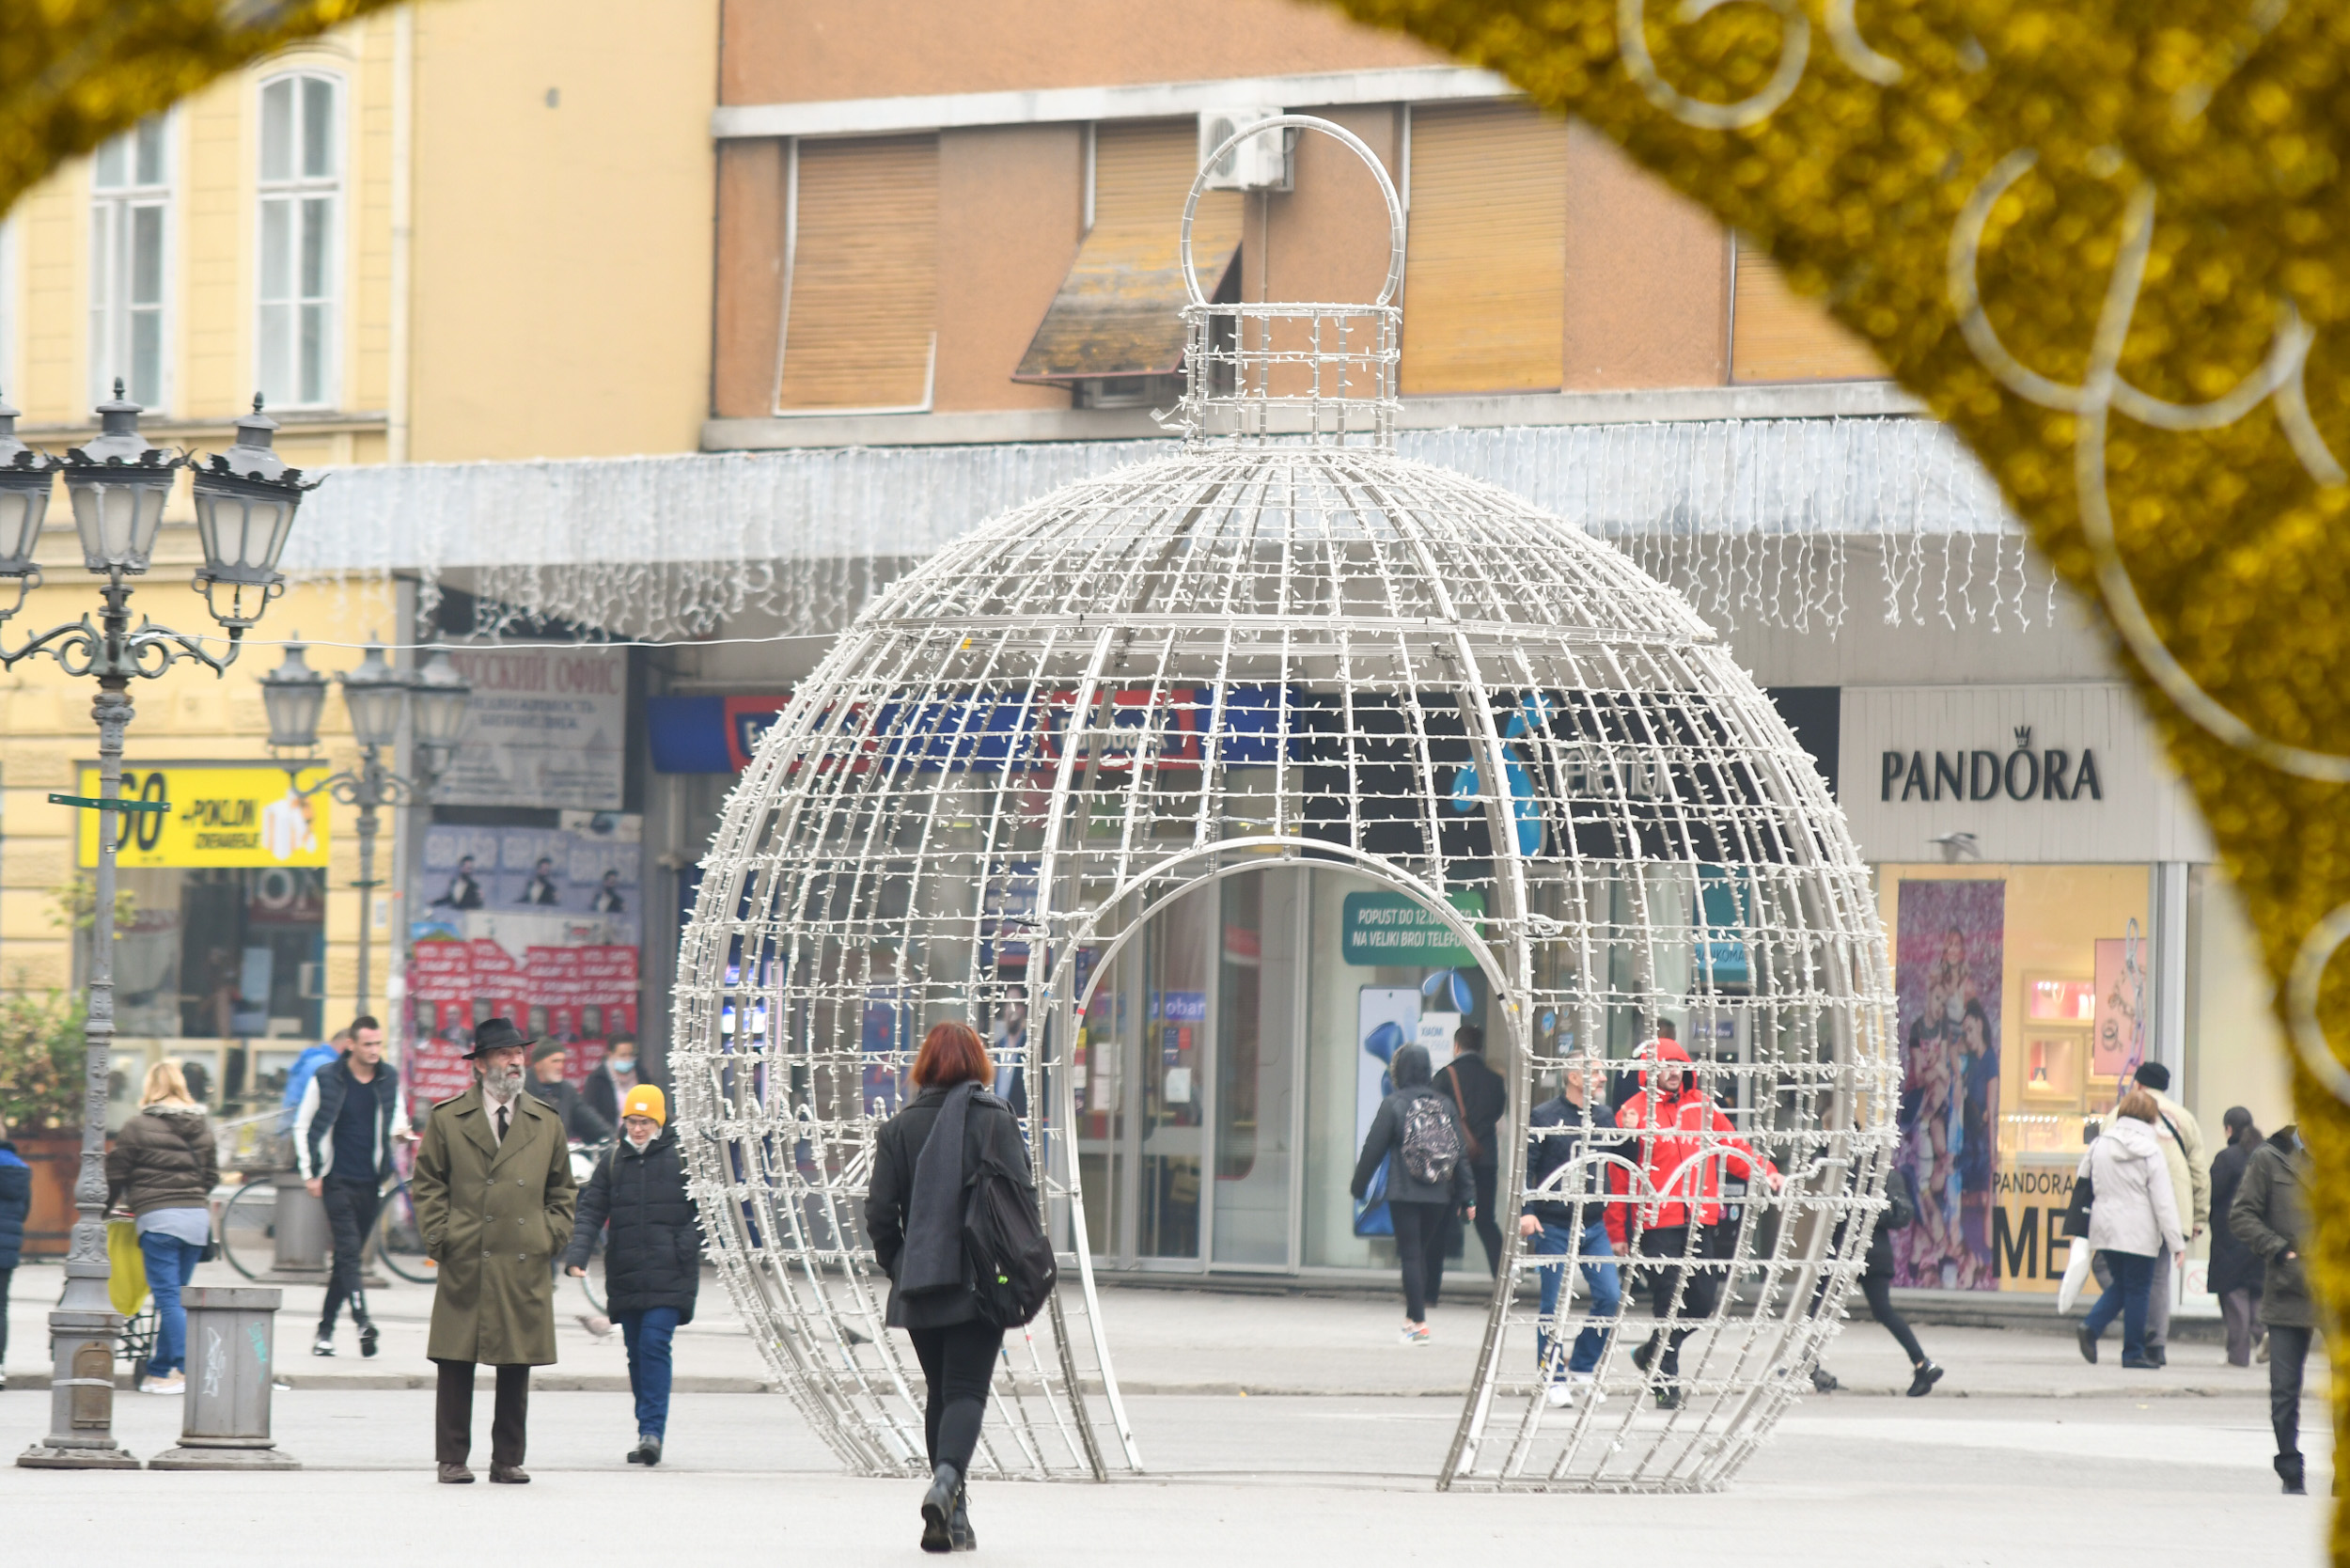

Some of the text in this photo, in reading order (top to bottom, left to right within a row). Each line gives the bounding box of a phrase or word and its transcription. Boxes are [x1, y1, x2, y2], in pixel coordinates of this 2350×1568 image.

[1058, 714, 1168, 751] Euobak
[1881, 748, 2103, 802] PANDORA
[1358, 909, 1397, 924] POPUST
[1399, 909, 1413, 924] DO
[1353, 932, 1465, 947] NA VELIKI BROJ TELEFO
[1993, 1172, 2075, 1195] PANDORA
[1993, 1206, 2071, 1280] ME
